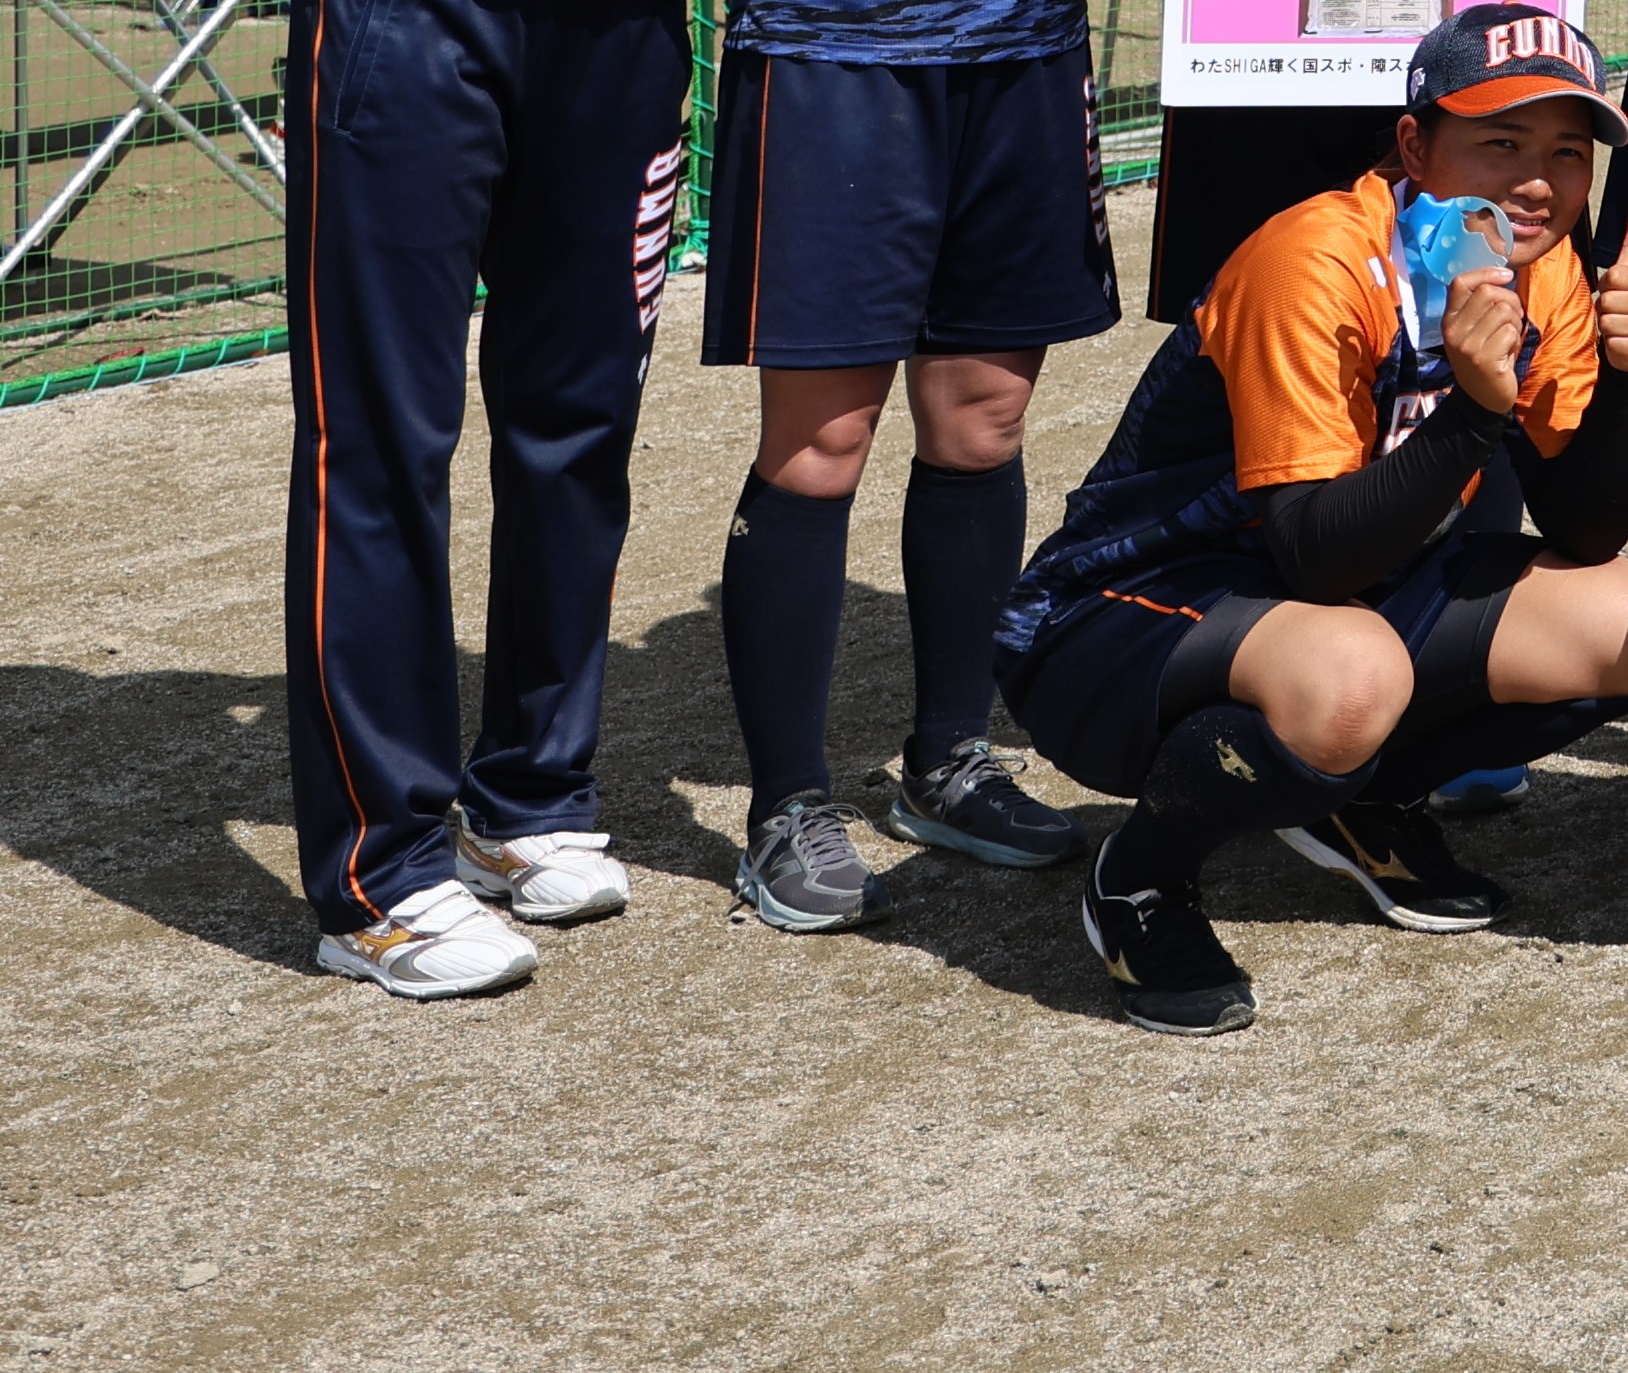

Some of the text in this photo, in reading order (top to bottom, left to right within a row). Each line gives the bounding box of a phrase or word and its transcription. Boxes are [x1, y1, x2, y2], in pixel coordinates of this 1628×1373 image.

[1190, 57, 1412, 76] わたSHIGA輝く国スポ・障ス
[1484, 17, 1597, 92] GUNMA
